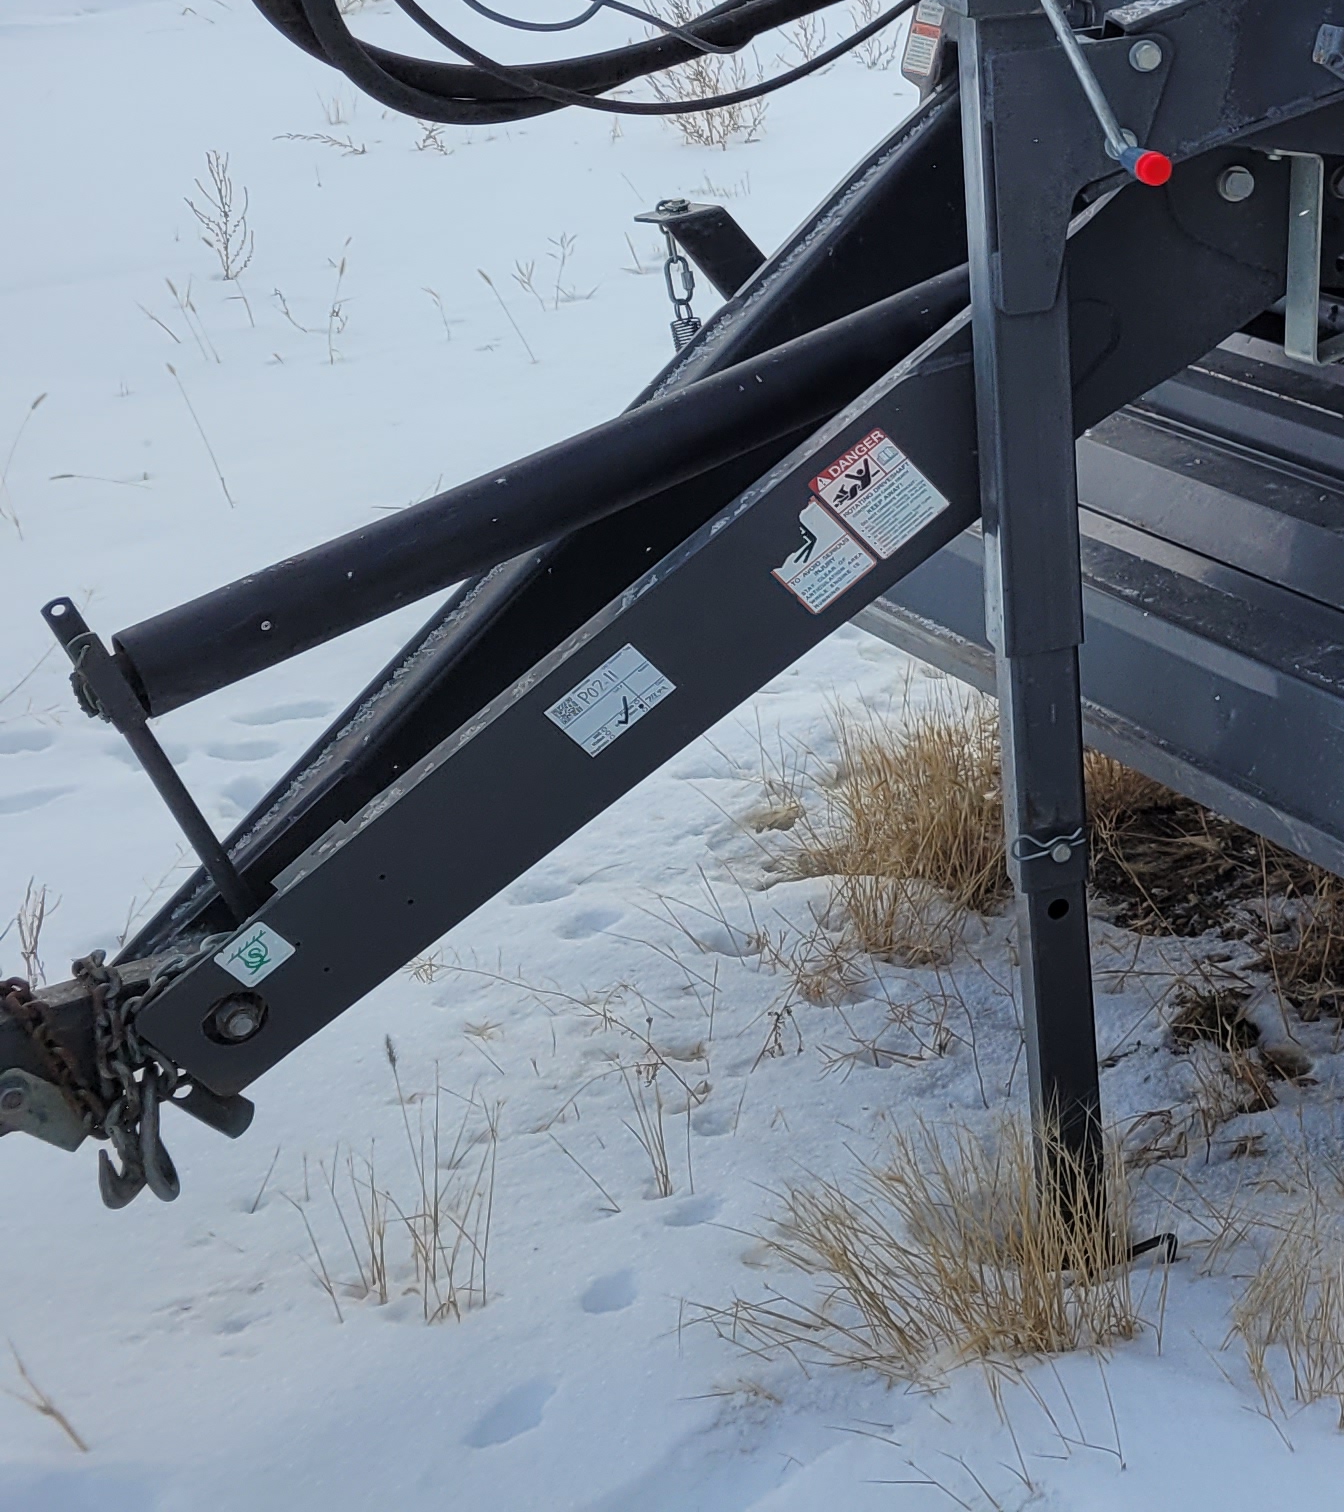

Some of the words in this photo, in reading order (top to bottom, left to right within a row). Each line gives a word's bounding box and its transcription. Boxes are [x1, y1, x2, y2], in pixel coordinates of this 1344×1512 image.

[827, 430, 885, 479] DANGER
[842, 491, 874, 517] ROTATING
[872, 461, 910, 492] DRIVESHAFT
